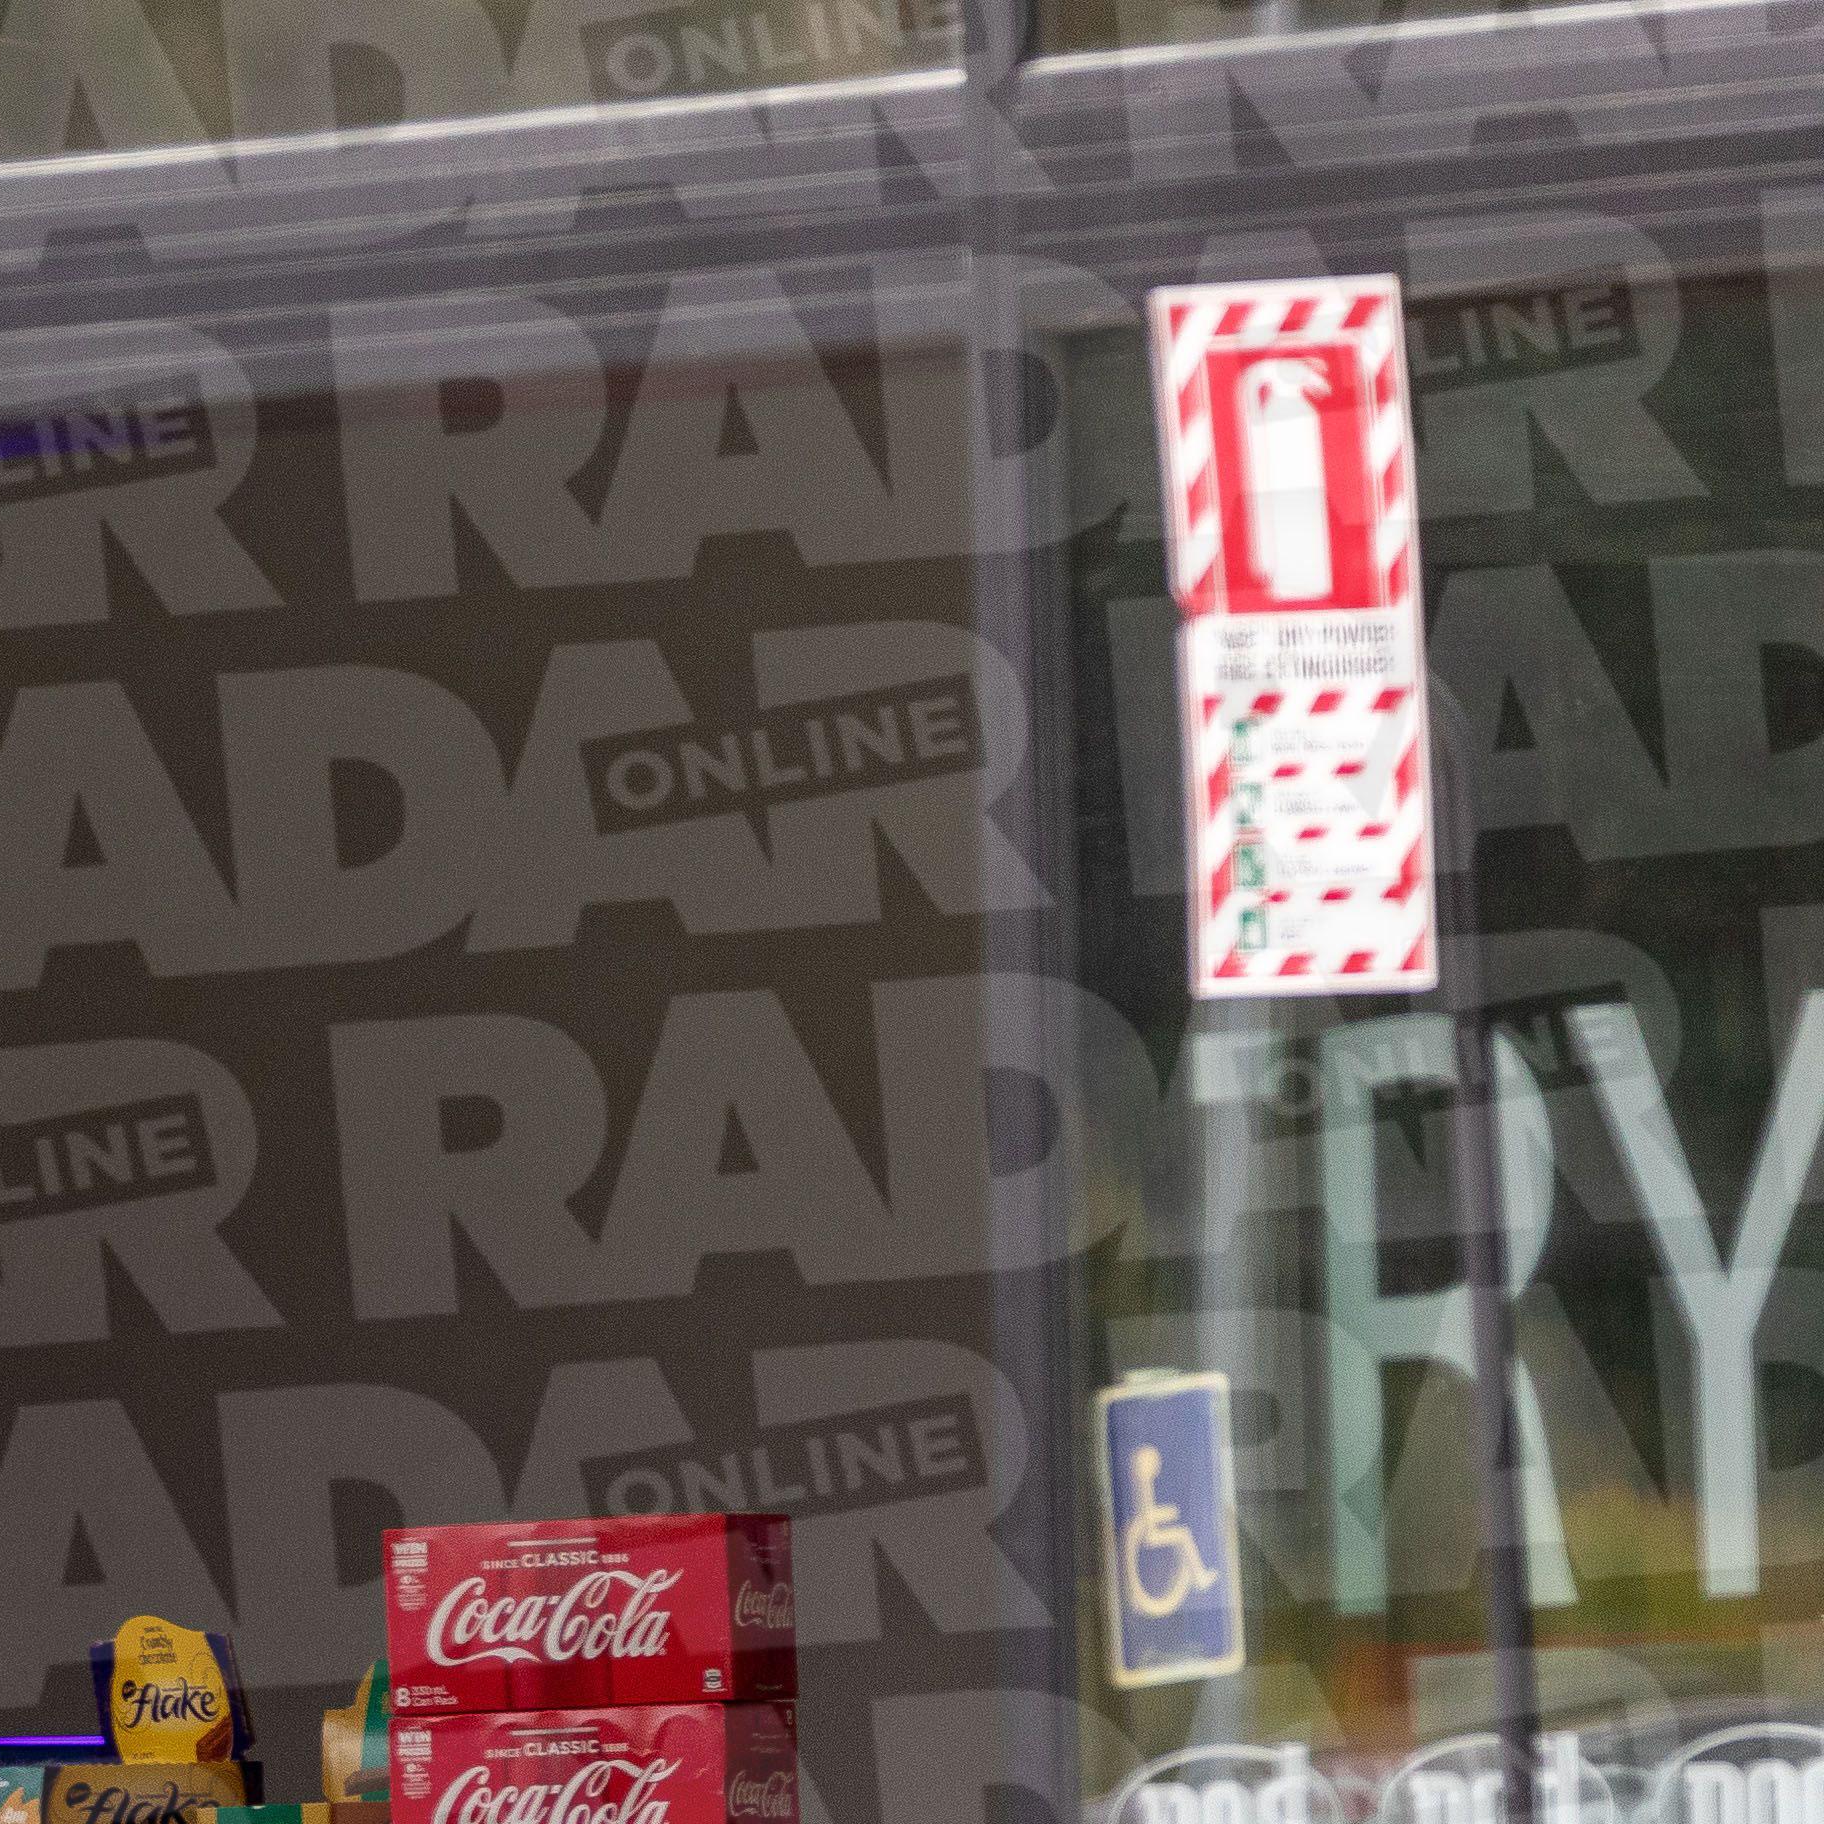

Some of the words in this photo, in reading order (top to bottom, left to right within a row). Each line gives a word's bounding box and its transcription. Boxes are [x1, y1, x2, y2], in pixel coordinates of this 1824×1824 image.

[521, 1551, 599, 1568] CLASSIC
[425, 1568, 684, 1667] Coca-Cola
[125, 1676, 220, 1729] flake
[522, 1740, 601, 1757] CLASSIC
